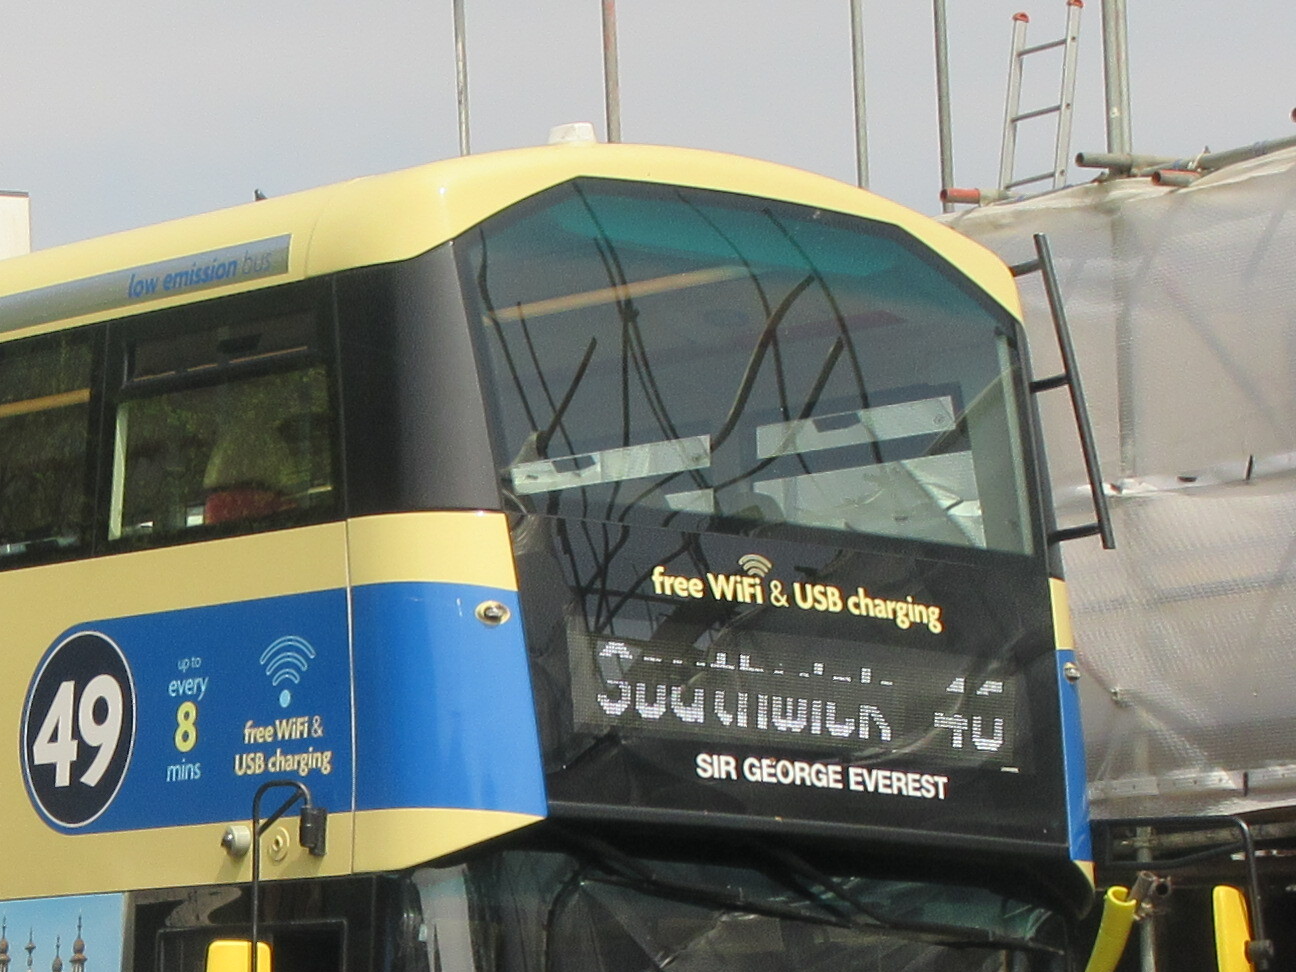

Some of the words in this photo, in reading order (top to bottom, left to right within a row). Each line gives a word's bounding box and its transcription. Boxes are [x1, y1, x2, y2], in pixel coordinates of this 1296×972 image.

[128, 273, 159, 298] low
[163, 257, 238, 291] emission
[242, 250, 272, 275] bus
[652, 565, 704, 599] free
[707, 571, 764, 605] WiFi
[769, 579, 789, 607] &
[792, 583, 843, 613] USB
[847, 587, 943, 634] charging
[178, 658, 189, 673] up
[190, 656, 202, 669] to
[168, 675, 209, 701] every
[33, 674, 123, 788] 49
[174, 701, 198, 752] 8
[243, 720, 274, 744] free
[275, 717, 309, 740] WiFi
[311, 715, 324, 738] &
[166, 758, 202, 783] mins
[234, 753, 265, 777] USB
[268, 749, 332, 777] charging
[695, 753, 737, 781] SIR
[742, 756, 843, 790] GEORGE
[848, 766, 949, 800] EVEREST
